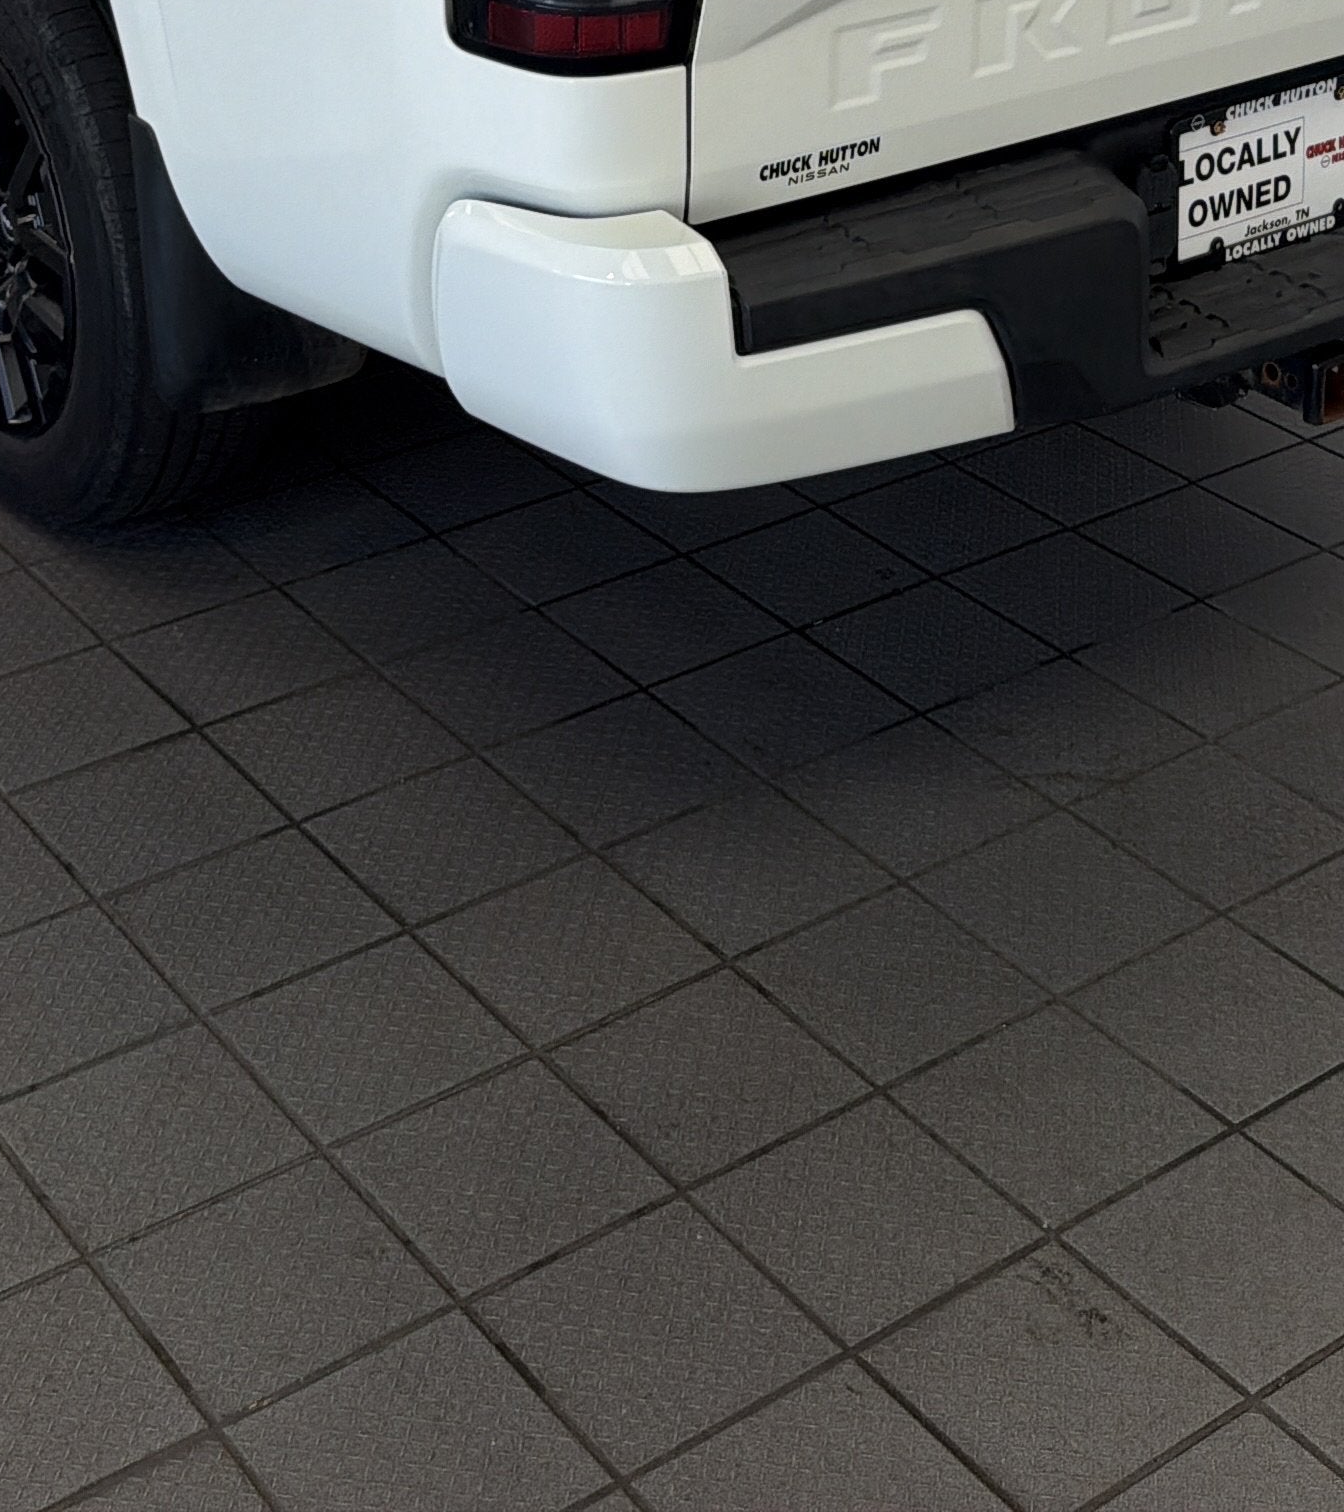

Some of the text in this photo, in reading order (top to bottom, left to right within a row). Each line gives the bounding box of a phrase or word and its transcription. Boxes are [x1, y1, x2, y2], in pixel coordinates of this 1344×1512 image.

[1225, 77, 1338, 121] CHUCK HUTTON
[759, 137, 881, 181] CHUCK HUTTON
[1178, 126, 1301, 185] LOCALLY
[1306, 138, 1336, 159] CHUCK
[787, 162, 851, 186] NISSAN
[1188, 174, 1292, 228] OWNED
[1244, 207, 1310, 238] Jackson, TN
[1225, 215, 1336, 262] LOCALLY OWNED
